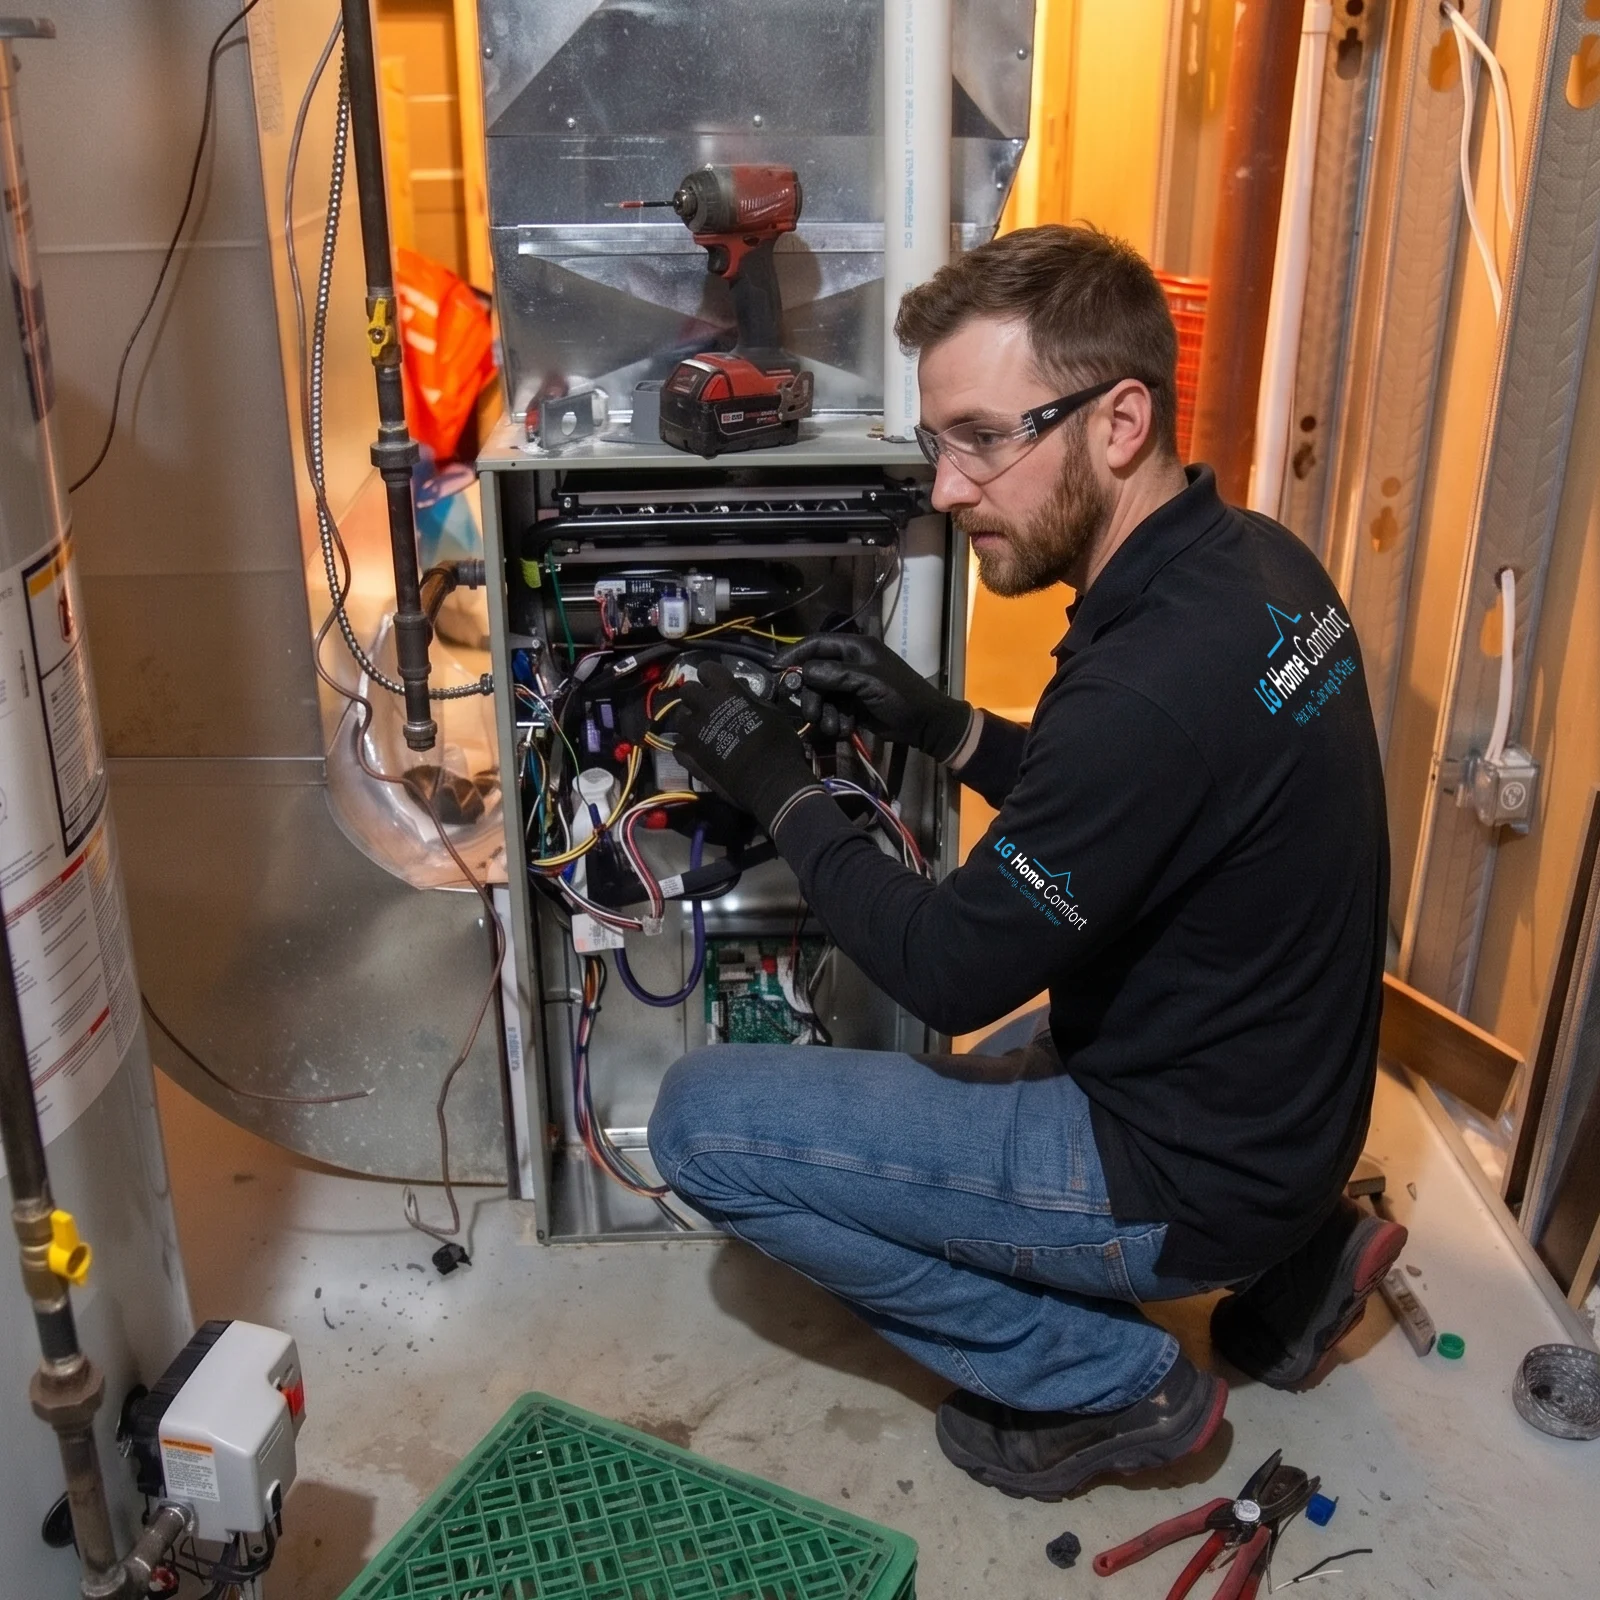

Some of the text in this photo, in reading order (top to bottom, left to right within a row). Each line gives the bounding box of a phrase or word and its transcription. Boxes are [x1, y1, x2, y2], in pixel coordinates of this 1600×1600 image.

[1253, 604, 1350, 715] LG Home Comfort
[993, 836, 1088, 931] LG Home Comfort
[997, 863, 1062, 927] Heating, Cooling & Water
